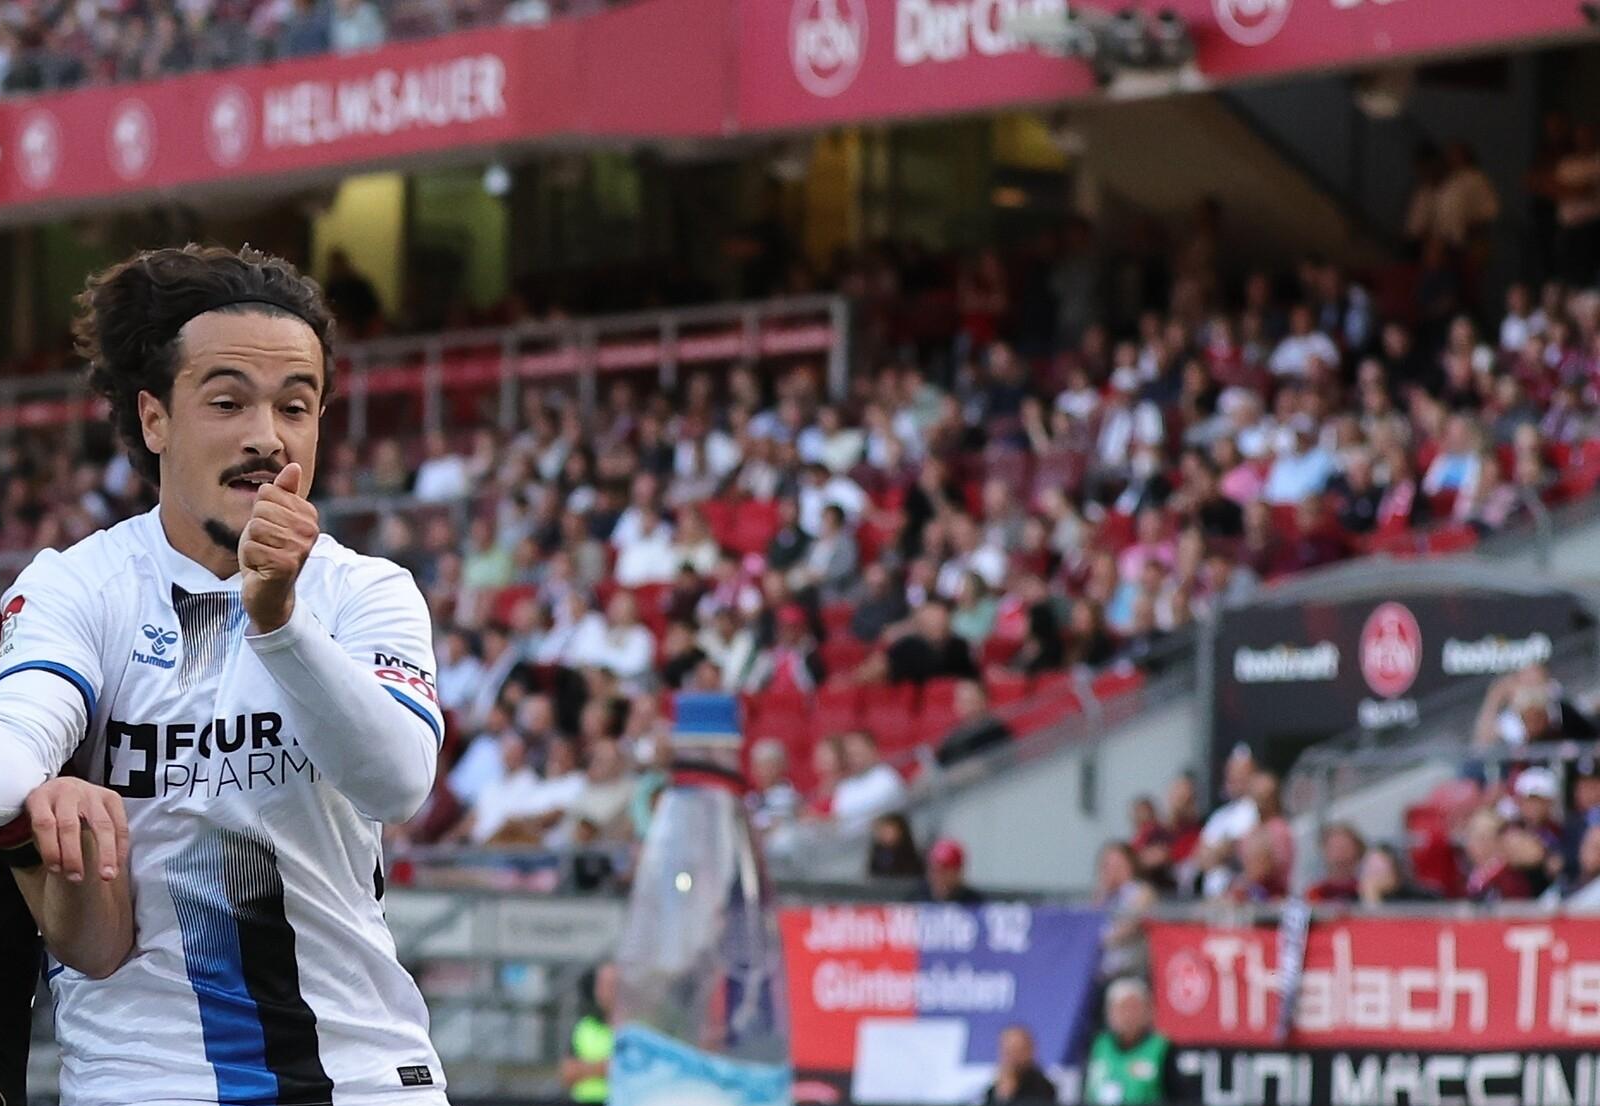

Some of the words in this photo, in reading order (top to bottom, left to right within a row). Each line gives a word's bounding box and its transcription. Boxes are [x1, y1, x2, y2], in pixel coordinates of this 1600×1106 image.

[263, 56, 504, 146] HELMSAUER
[131, 649, 177, 669] hummel
[163, 749, 321, 798] PHARM
[1204, 926, 1488, 1033] Thalach
